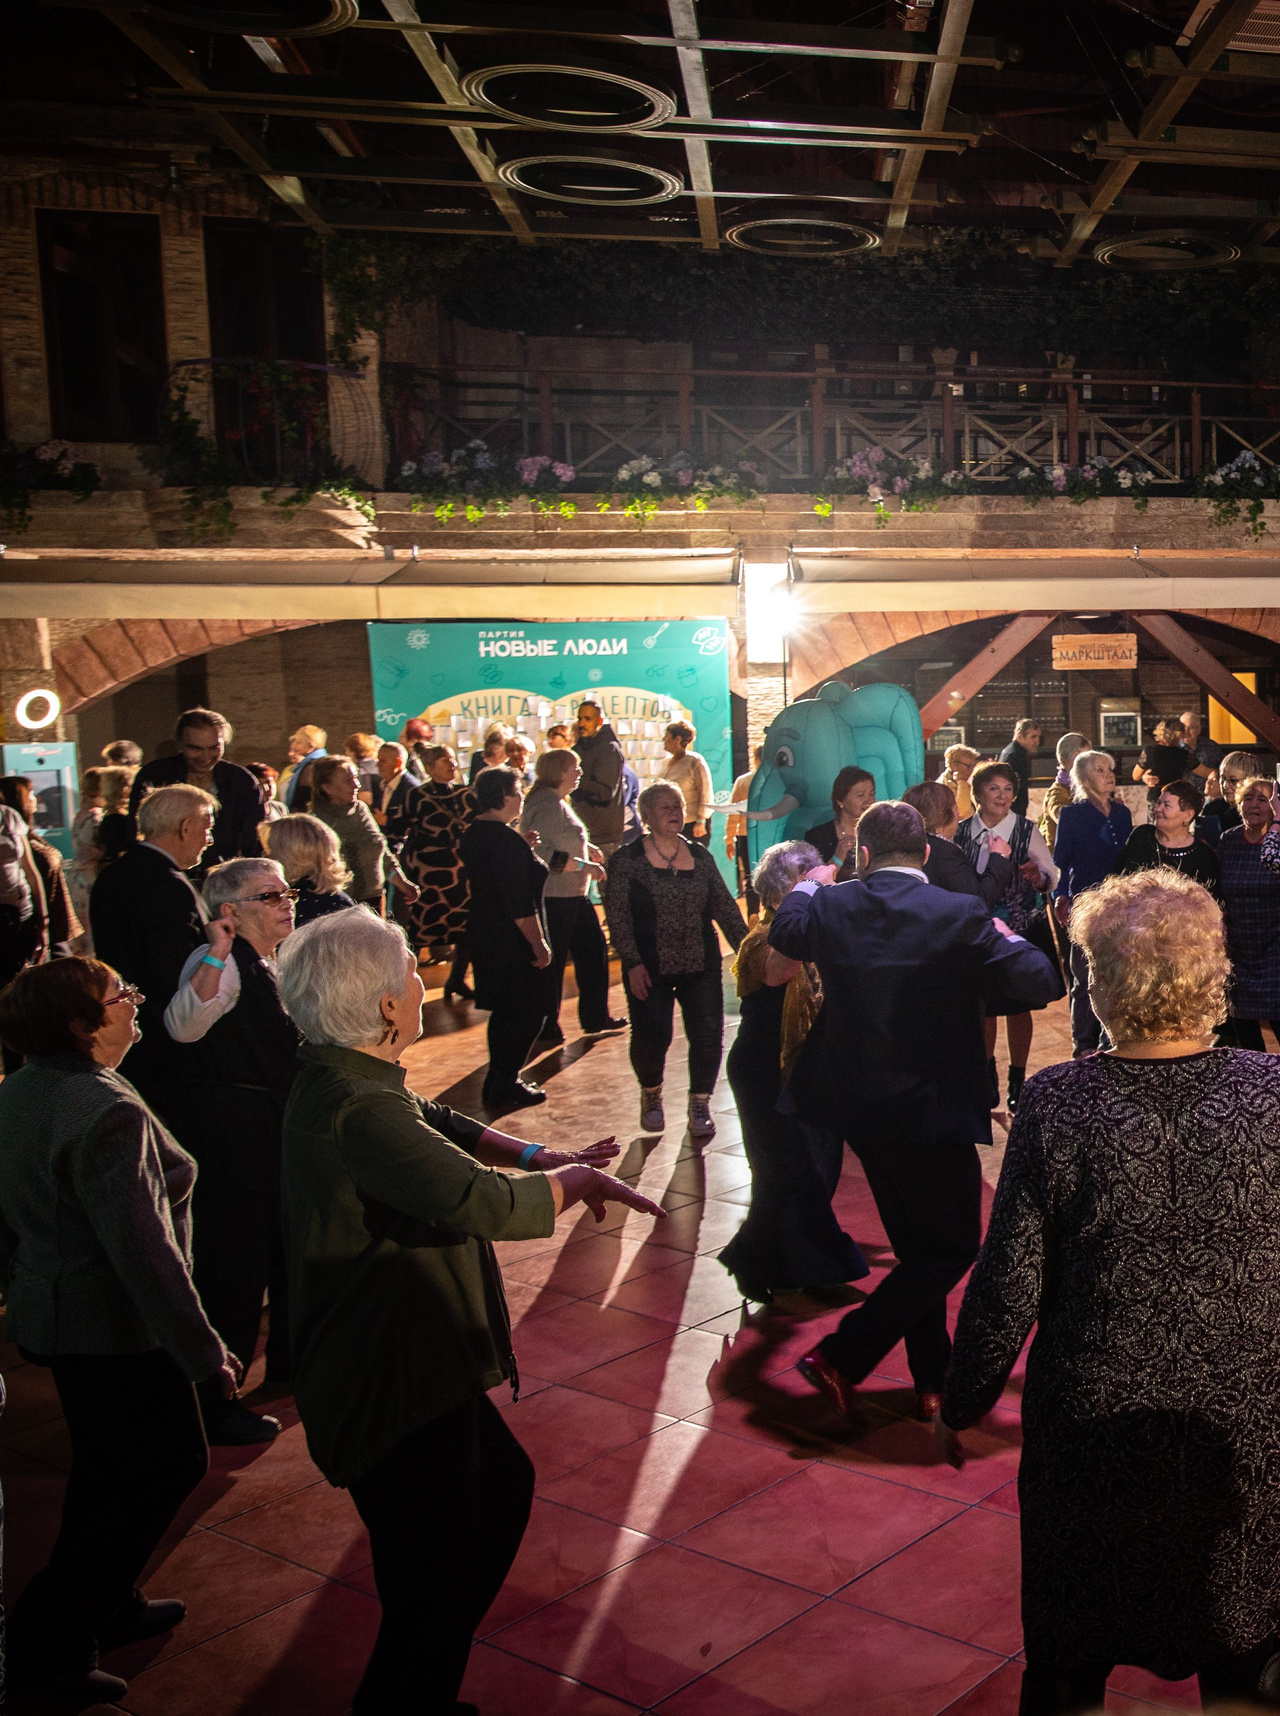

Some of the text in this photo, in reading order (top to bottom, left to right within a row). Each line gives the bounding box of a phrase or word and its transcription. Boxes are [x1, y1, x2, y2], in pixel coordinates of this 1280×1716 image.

[478, 630, 525, 638] ПАРТИЯ
[478, 638, 629, 657] НОВЫЕ ЛЮДИ
[1059, 649, 1132, 661] МАРКШТАДТ
[460, 695, 532, 719] КНИГА
